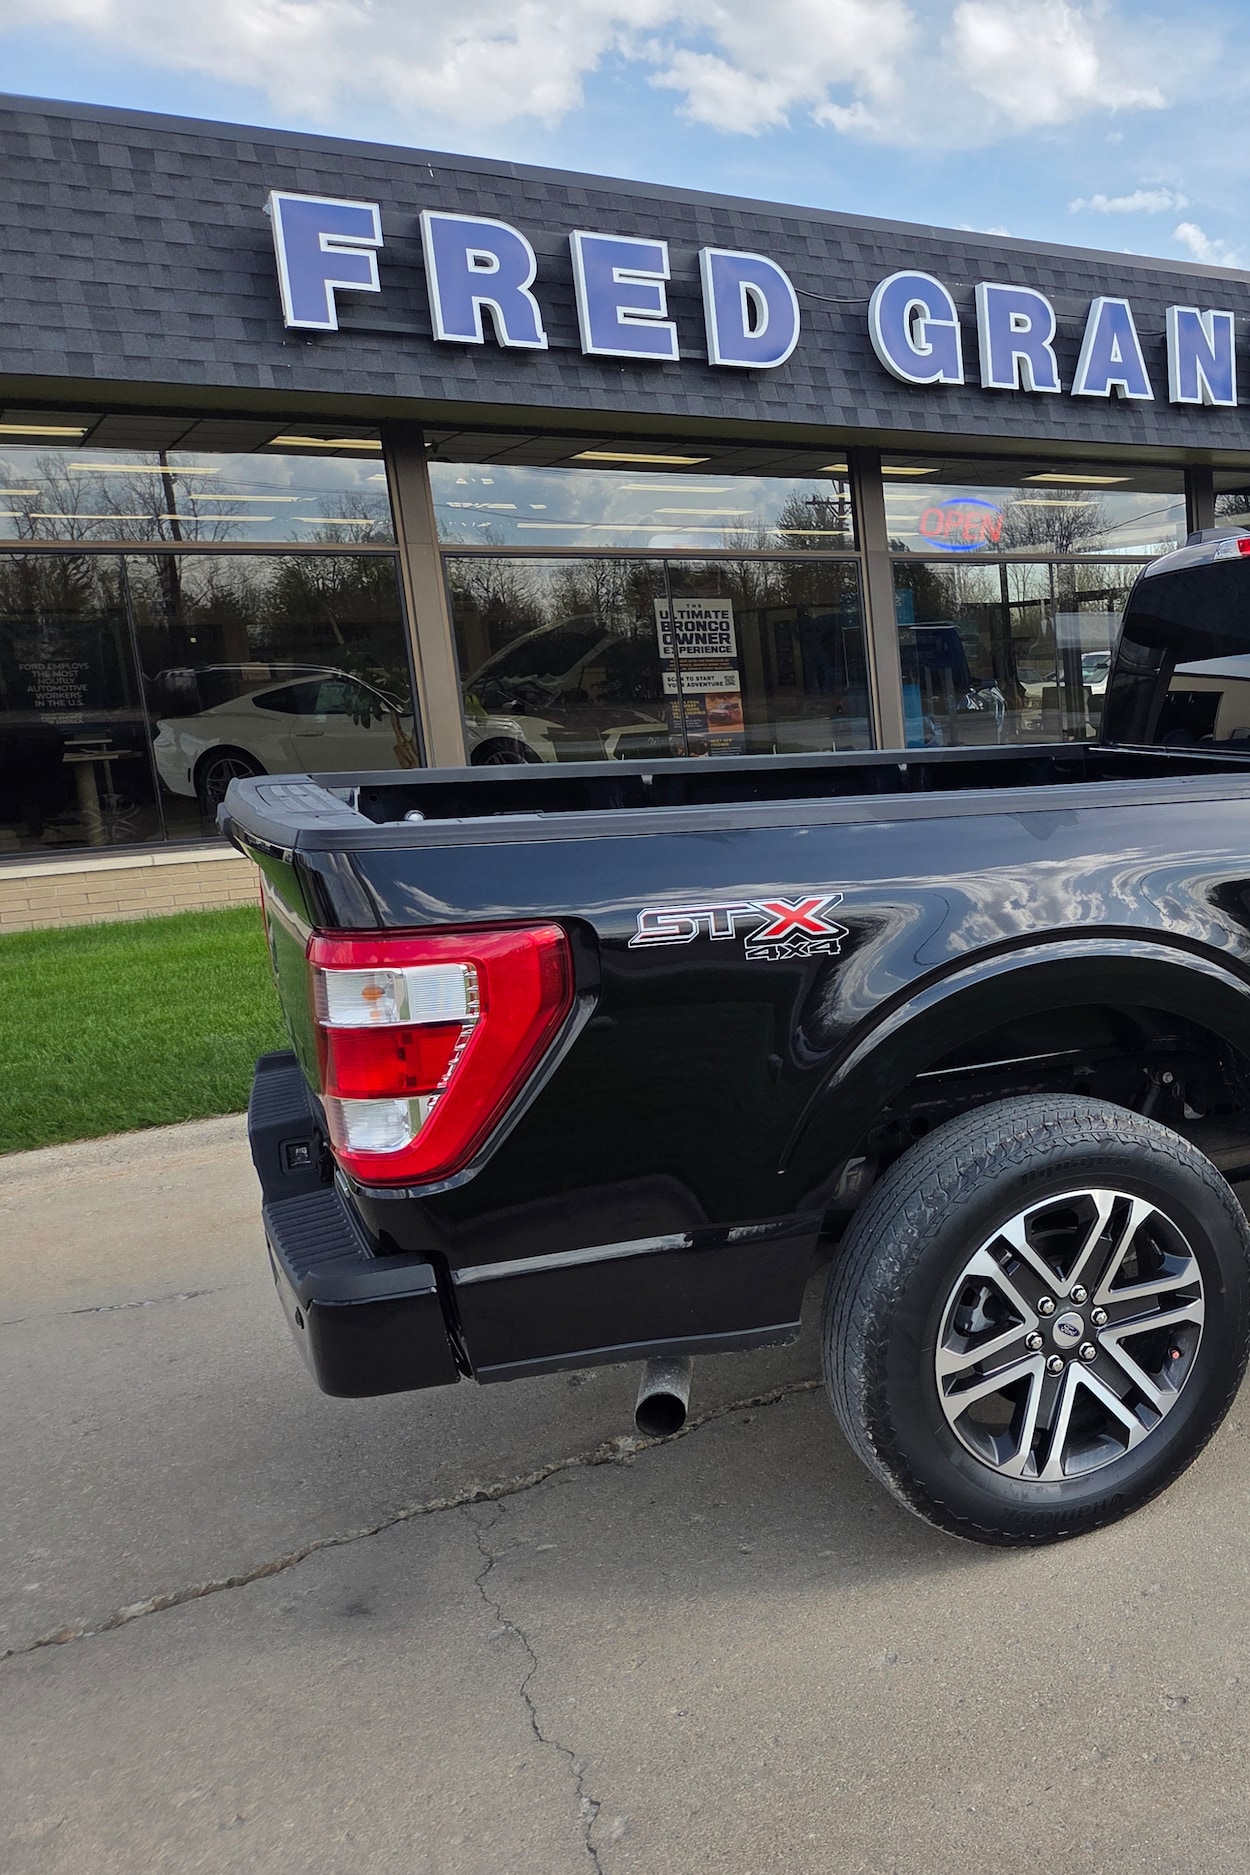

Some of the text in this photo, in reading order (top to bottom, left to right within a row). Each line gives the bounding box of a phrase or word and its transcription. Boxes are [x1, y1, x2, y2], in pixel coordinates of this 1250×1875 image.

[270, 190, 801, 369] FRED
[919, 507, 1004, 543] OPEN
[659, 610, 729, 619] UTIMATE
[661, 620, 730, 632] BRONCO
[662, 633, 731, 645] OWNER
[19, 662, 90, 671] FORD EMPLOYS
[32, 670, 50, 678] THE
[37, 677, 75, 685] HOURLY
[27, 684, 88, 692] AUTOMOTIVE
[35, 692, 82, 700] WORKERS
[628, 893, 850, 949] STX
